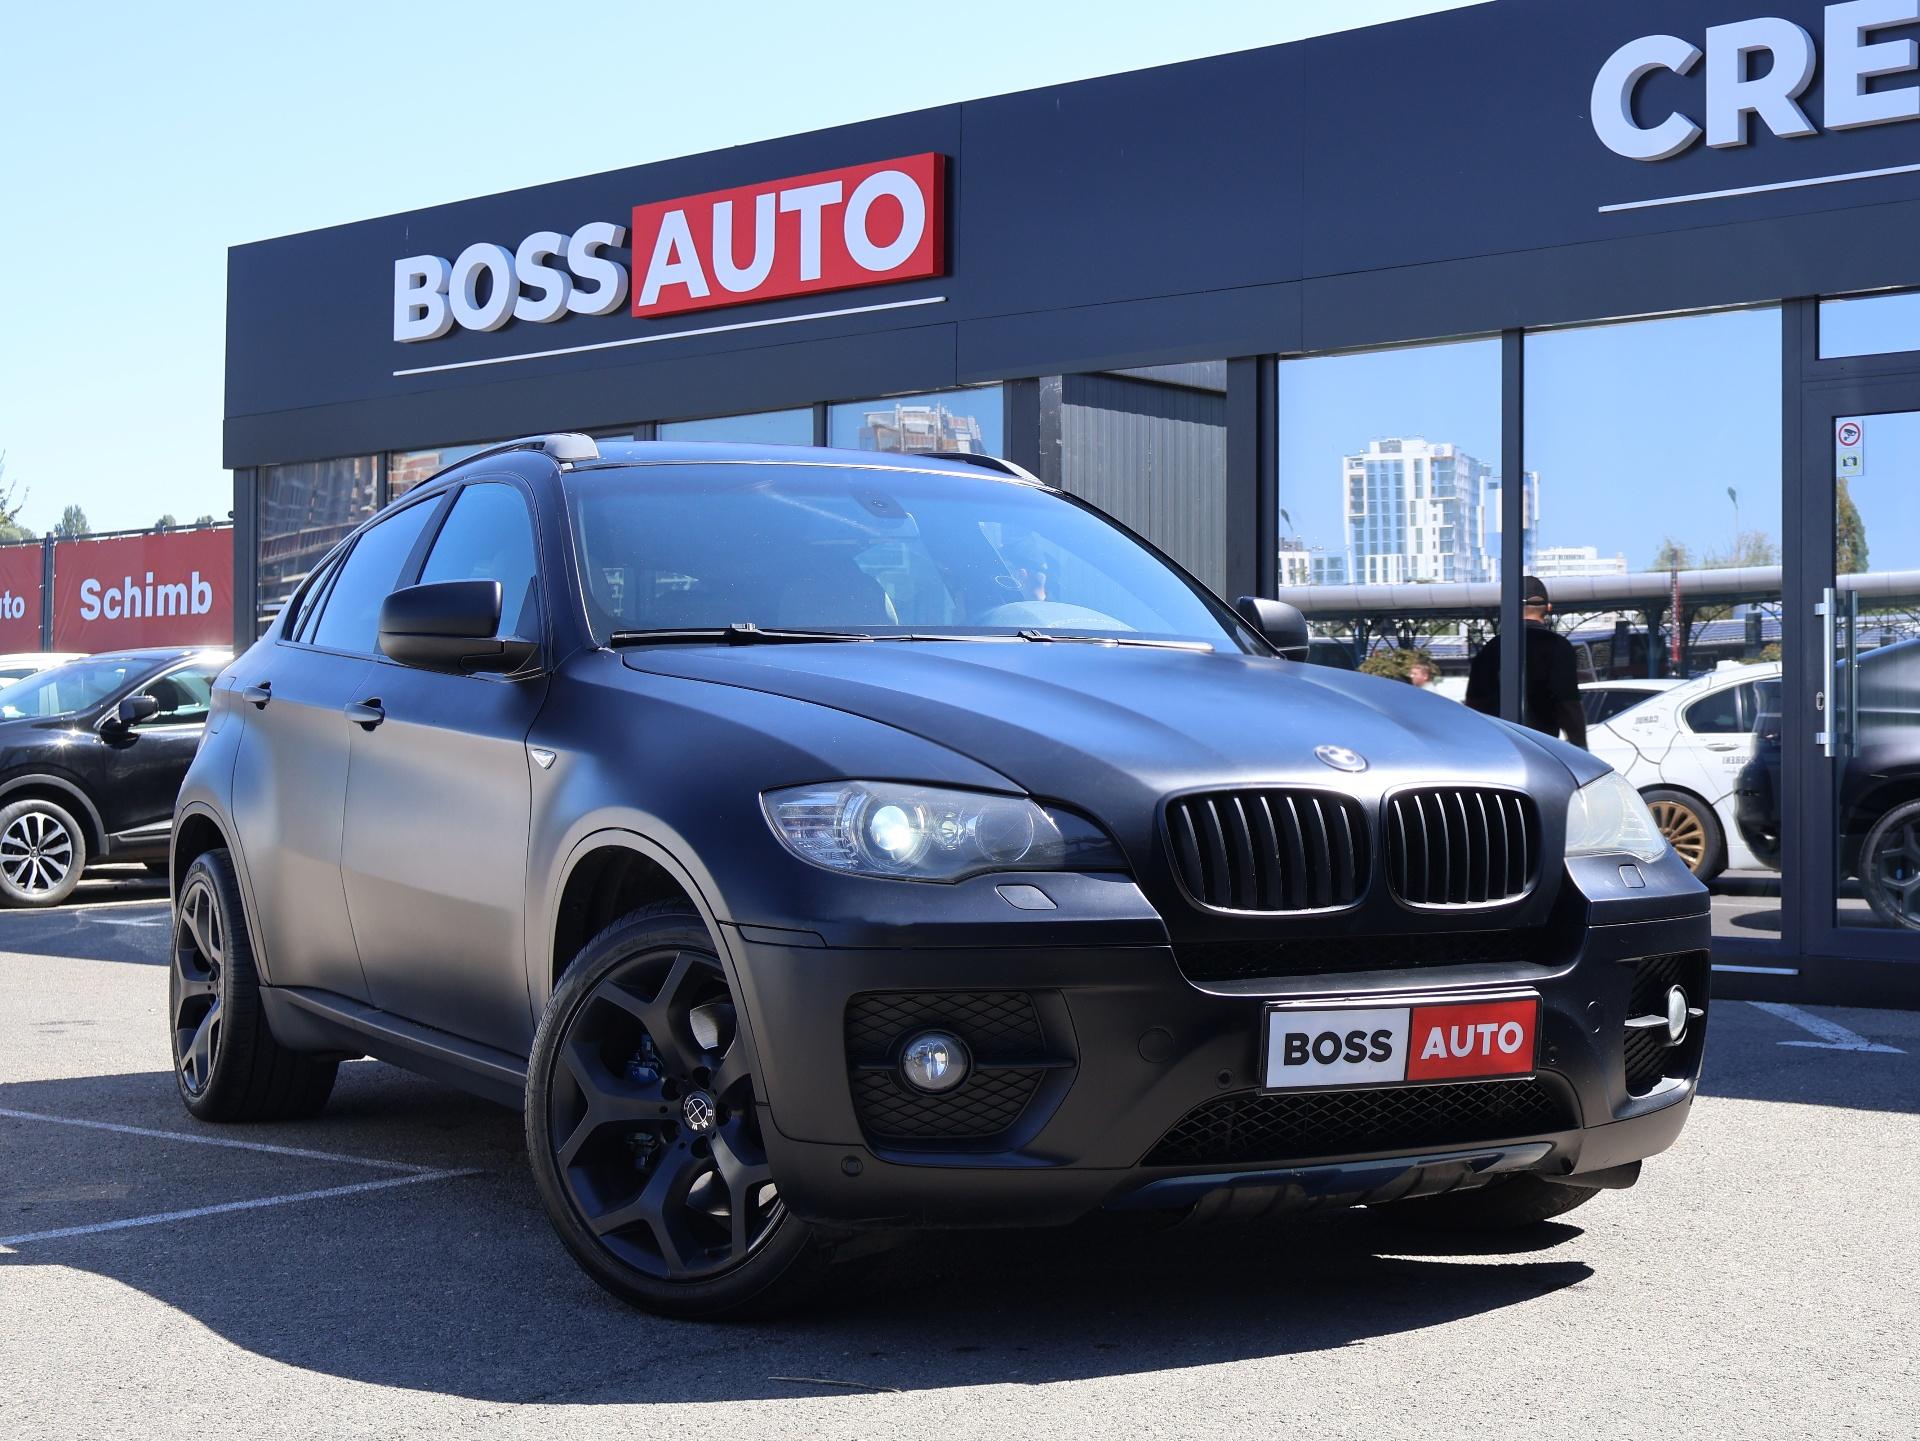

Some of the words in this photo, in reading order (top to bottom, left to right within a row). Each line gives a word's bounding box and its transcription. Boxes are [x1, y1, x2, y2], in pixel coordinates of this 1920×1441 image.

[393, 221, 628, 343] BOSS
[638, 170, 926, 307] AUTO
[80, 571, 213, 621] Schimb
[1283, 1029, 1393, 1066] BOSS
[1420, 1021, 1524, 1060] AUTO
